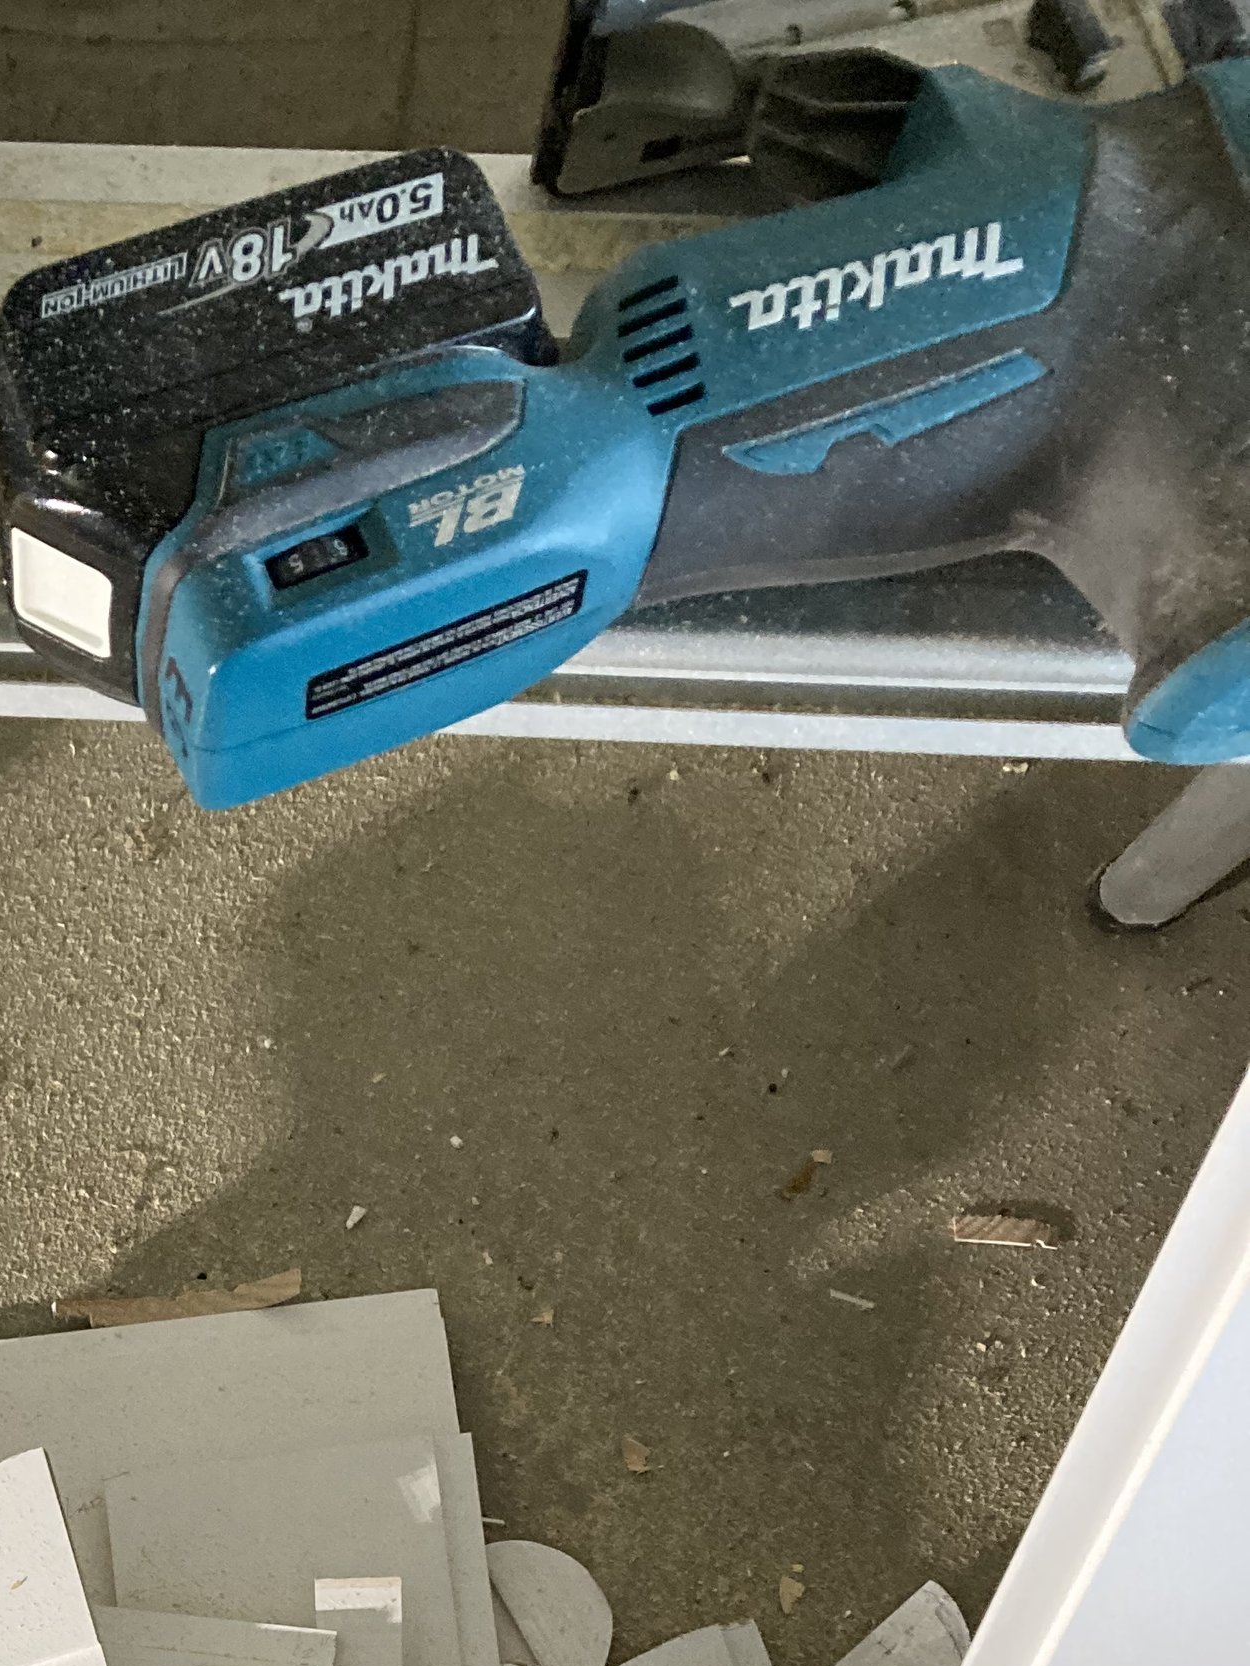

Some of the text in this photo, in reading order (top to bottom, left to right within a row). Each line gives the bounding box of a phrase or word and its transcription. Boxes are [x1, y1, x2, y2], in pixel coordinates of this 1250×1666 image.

[338, 182, 435, 223] 5.0Ah
[188, 217, 297, 288] 18V
[408, 464, 526, 514] MOTOR
[410, 482, 522, 547] BL
